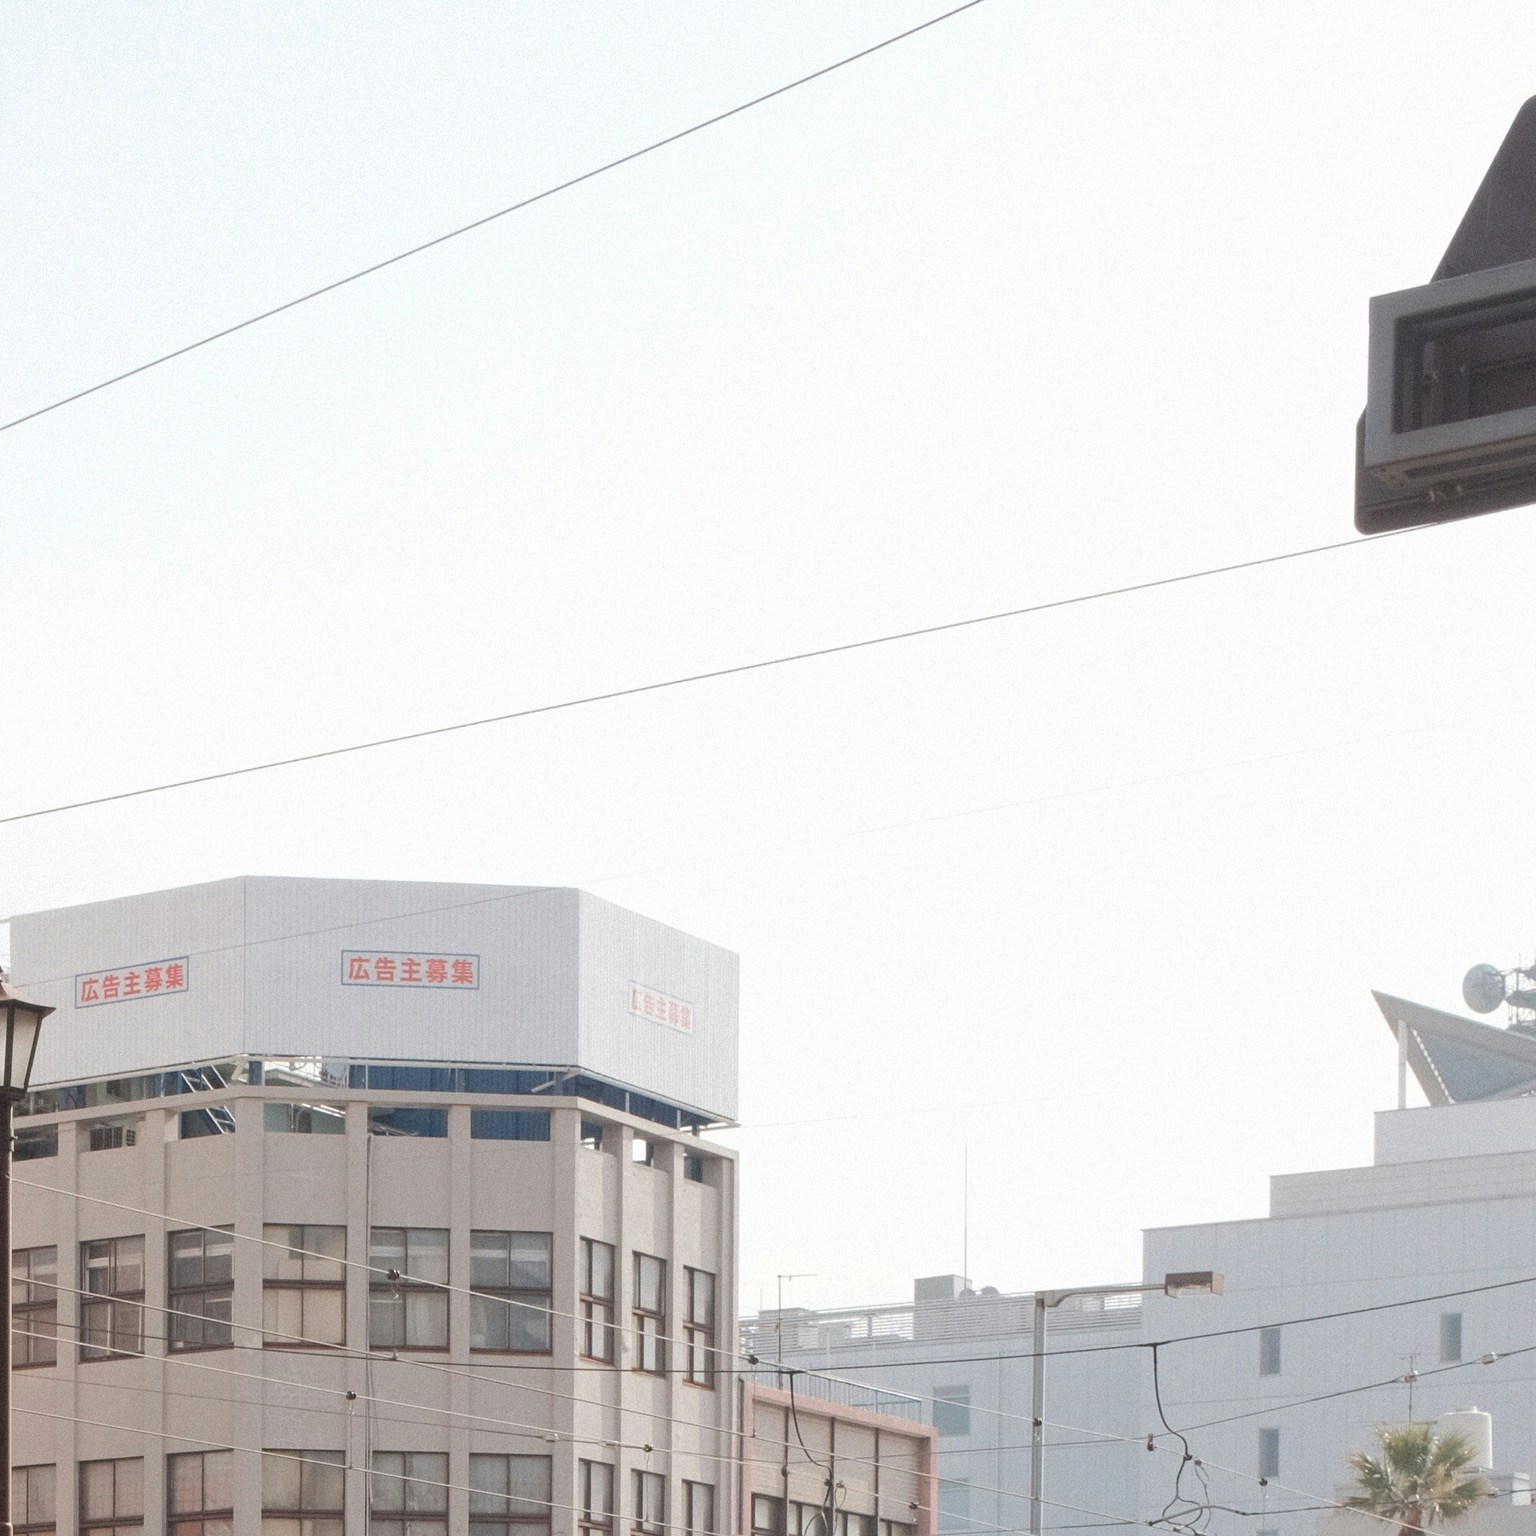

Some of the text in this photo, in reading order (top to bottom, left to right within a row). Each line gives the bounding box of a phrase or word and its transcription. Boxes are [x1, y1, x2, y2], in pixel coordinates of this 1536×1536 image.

[80, 963, 184, 1002] 広告主募集
[348, 955, 474, 985] 広告主募集
